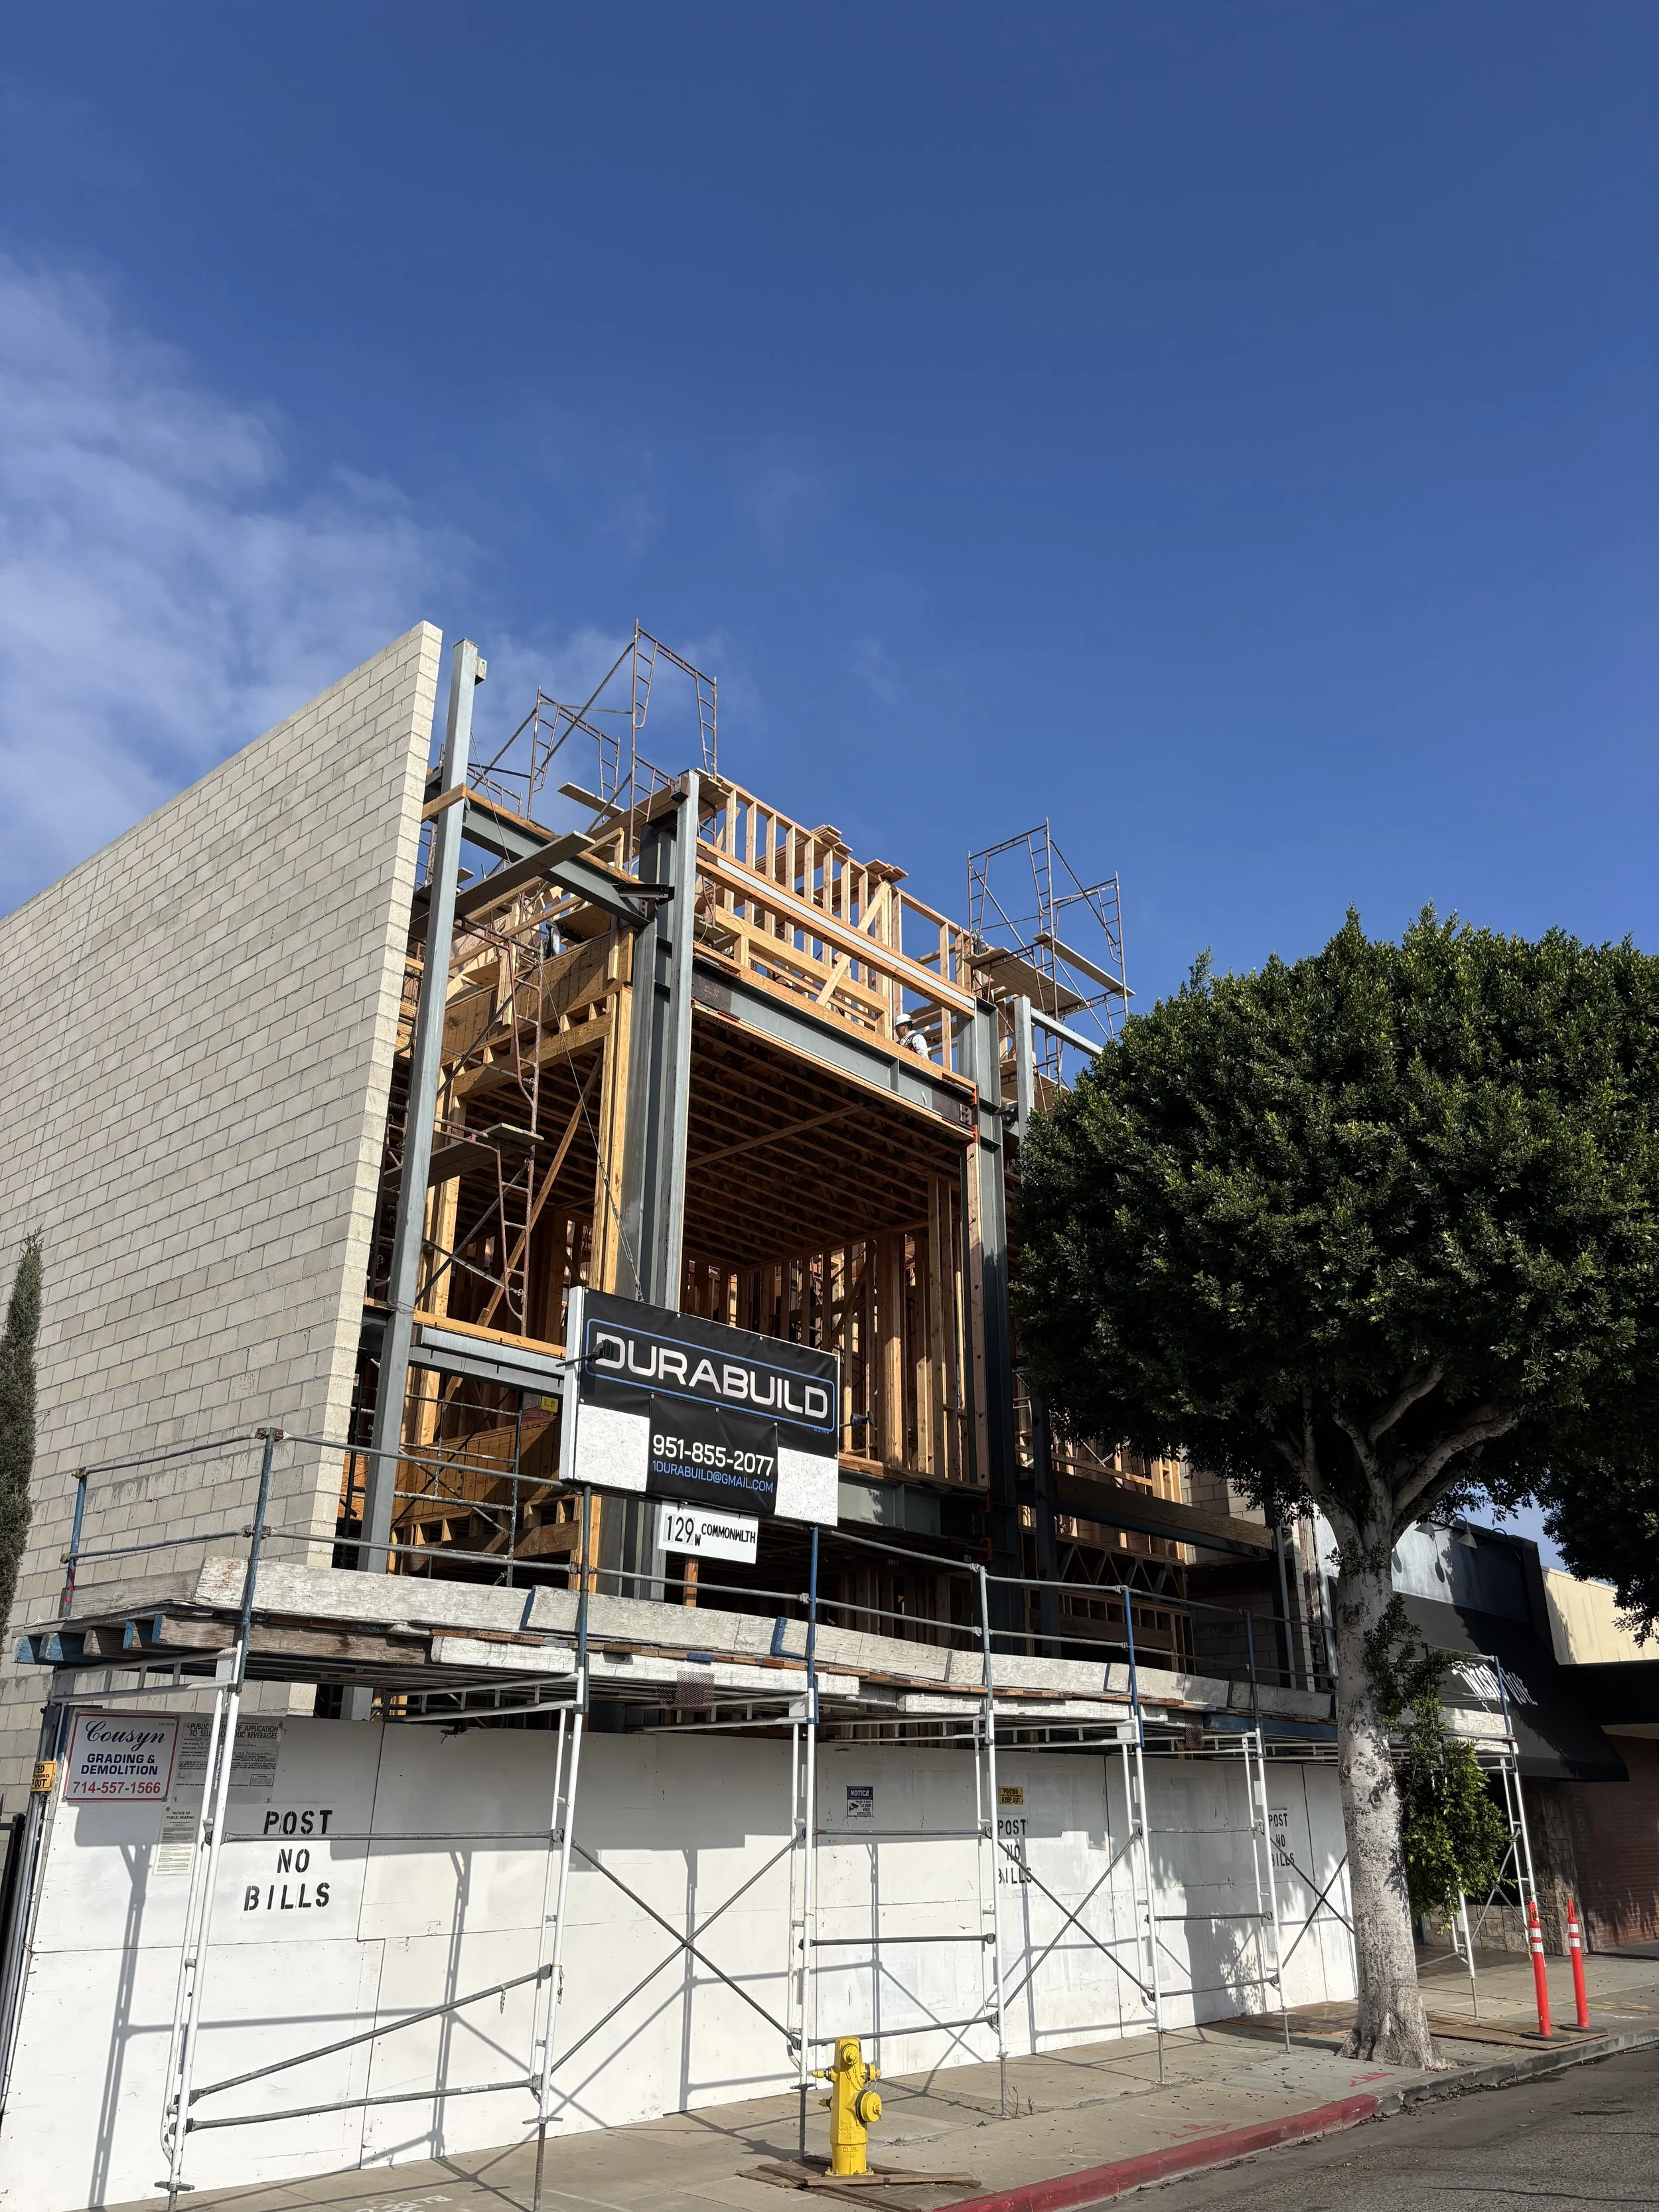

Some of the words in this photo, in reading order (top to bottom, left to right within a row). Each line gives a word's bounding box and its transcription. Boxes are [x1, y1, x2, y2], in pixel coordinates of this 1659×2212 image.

[596, 1332, 828, 1419] DURABUILD
[652, 1434, 774, 1477] 951-855-2077
[652, 1461, 774, 1493] 1DURABUILD@GMAIL.COM
[668, 1515, 694, 1543] 129
[695, 1534, 701, 1546] W
[701, 1523, 756, 1544] COMMONWLTH
[86, 1720, 166, 1751] Cousyn
[81, 1765, 158, 1775] DEMOLITION
[87, 1753, 145, 1763] GRADING
[147, 1755, 155, 1763] &
[73, 1781, 161, 1794] 714-557-1566
[263, 1810, 332, 1834] POST
[998, 1819, 1026, 1836] POST
[1268, 1813, 1287, 1827] POST
[1007, 1844, 1021, 1861] NO
[1275, 1834, 1285, 1848] NO
[277, 1848, 310, 1874] NO
[244, 1882, 330, 1911] BILLS
